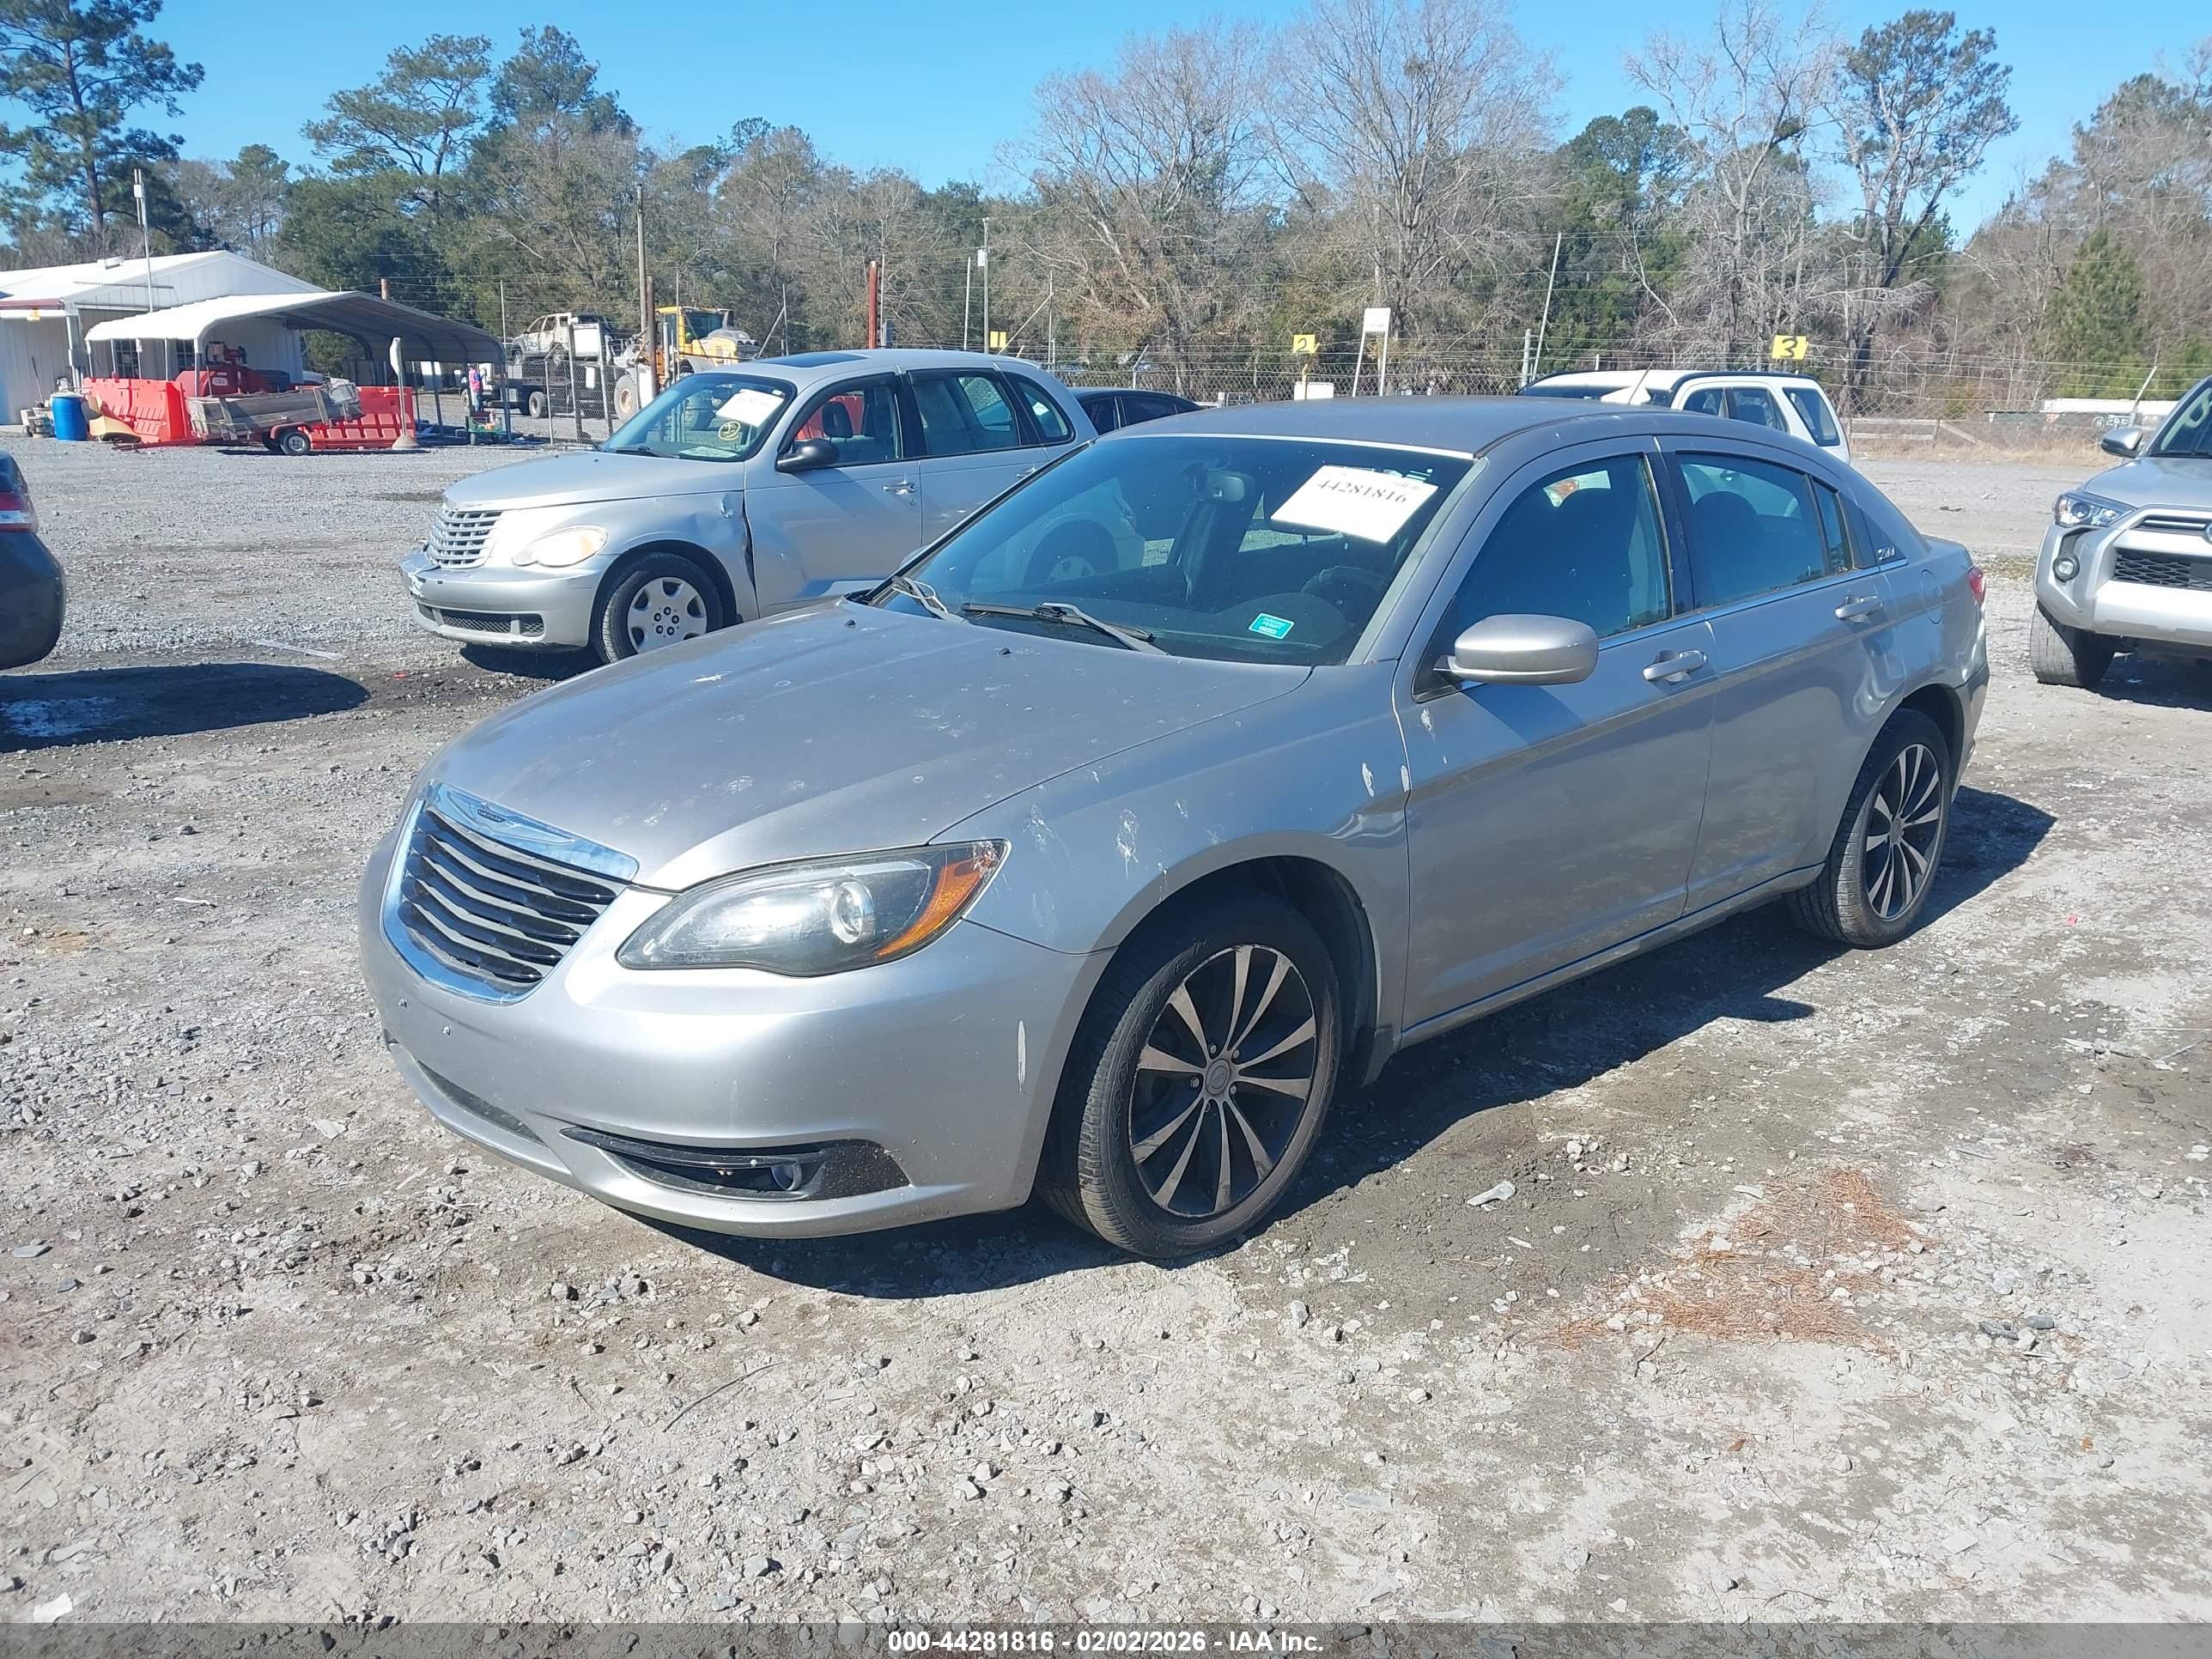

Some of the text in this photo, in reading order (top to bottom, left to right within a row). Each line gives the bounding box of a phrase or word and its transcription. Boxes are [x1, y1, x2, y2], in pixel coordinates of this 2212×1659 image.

[1297, 337, 1310, 353] 2
[1780, 336, 1798, 358] 3
[1316, 478, 1408, 504] 44281816
